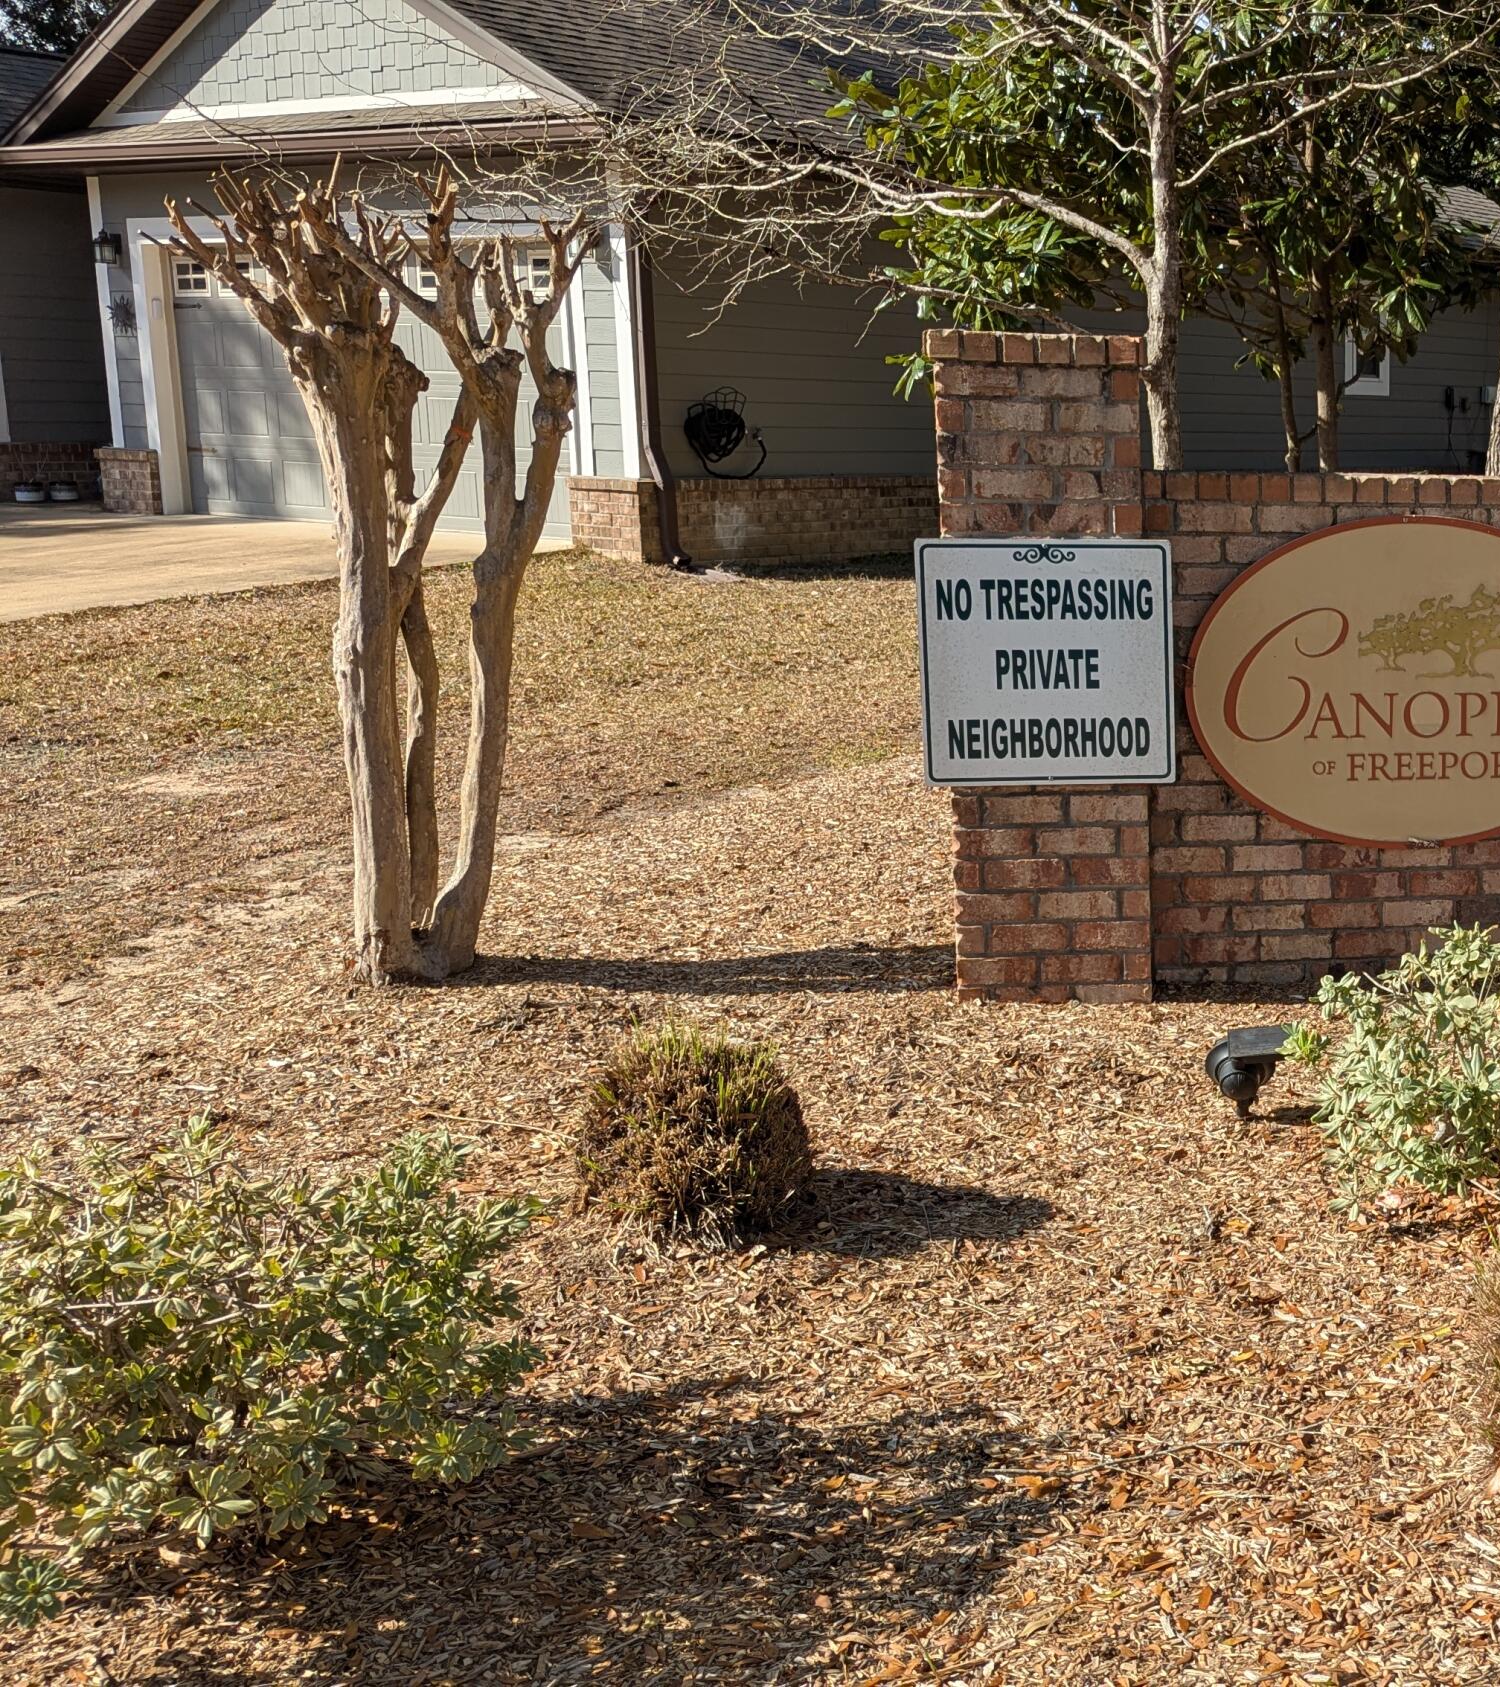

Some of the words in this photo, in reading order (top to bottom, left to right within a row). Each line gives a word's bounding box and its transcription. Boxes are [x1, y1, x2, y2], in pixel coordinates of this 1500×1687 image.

[936, 579, 972, 620] NO
[980, 578, 1153, 620] TRESPASSING
[996, 649, 1100, 690] PRIVATE
[948, 717, 1150, 759] NEIGHBORHOOD
[1312, 761, 1336, 776] OF
